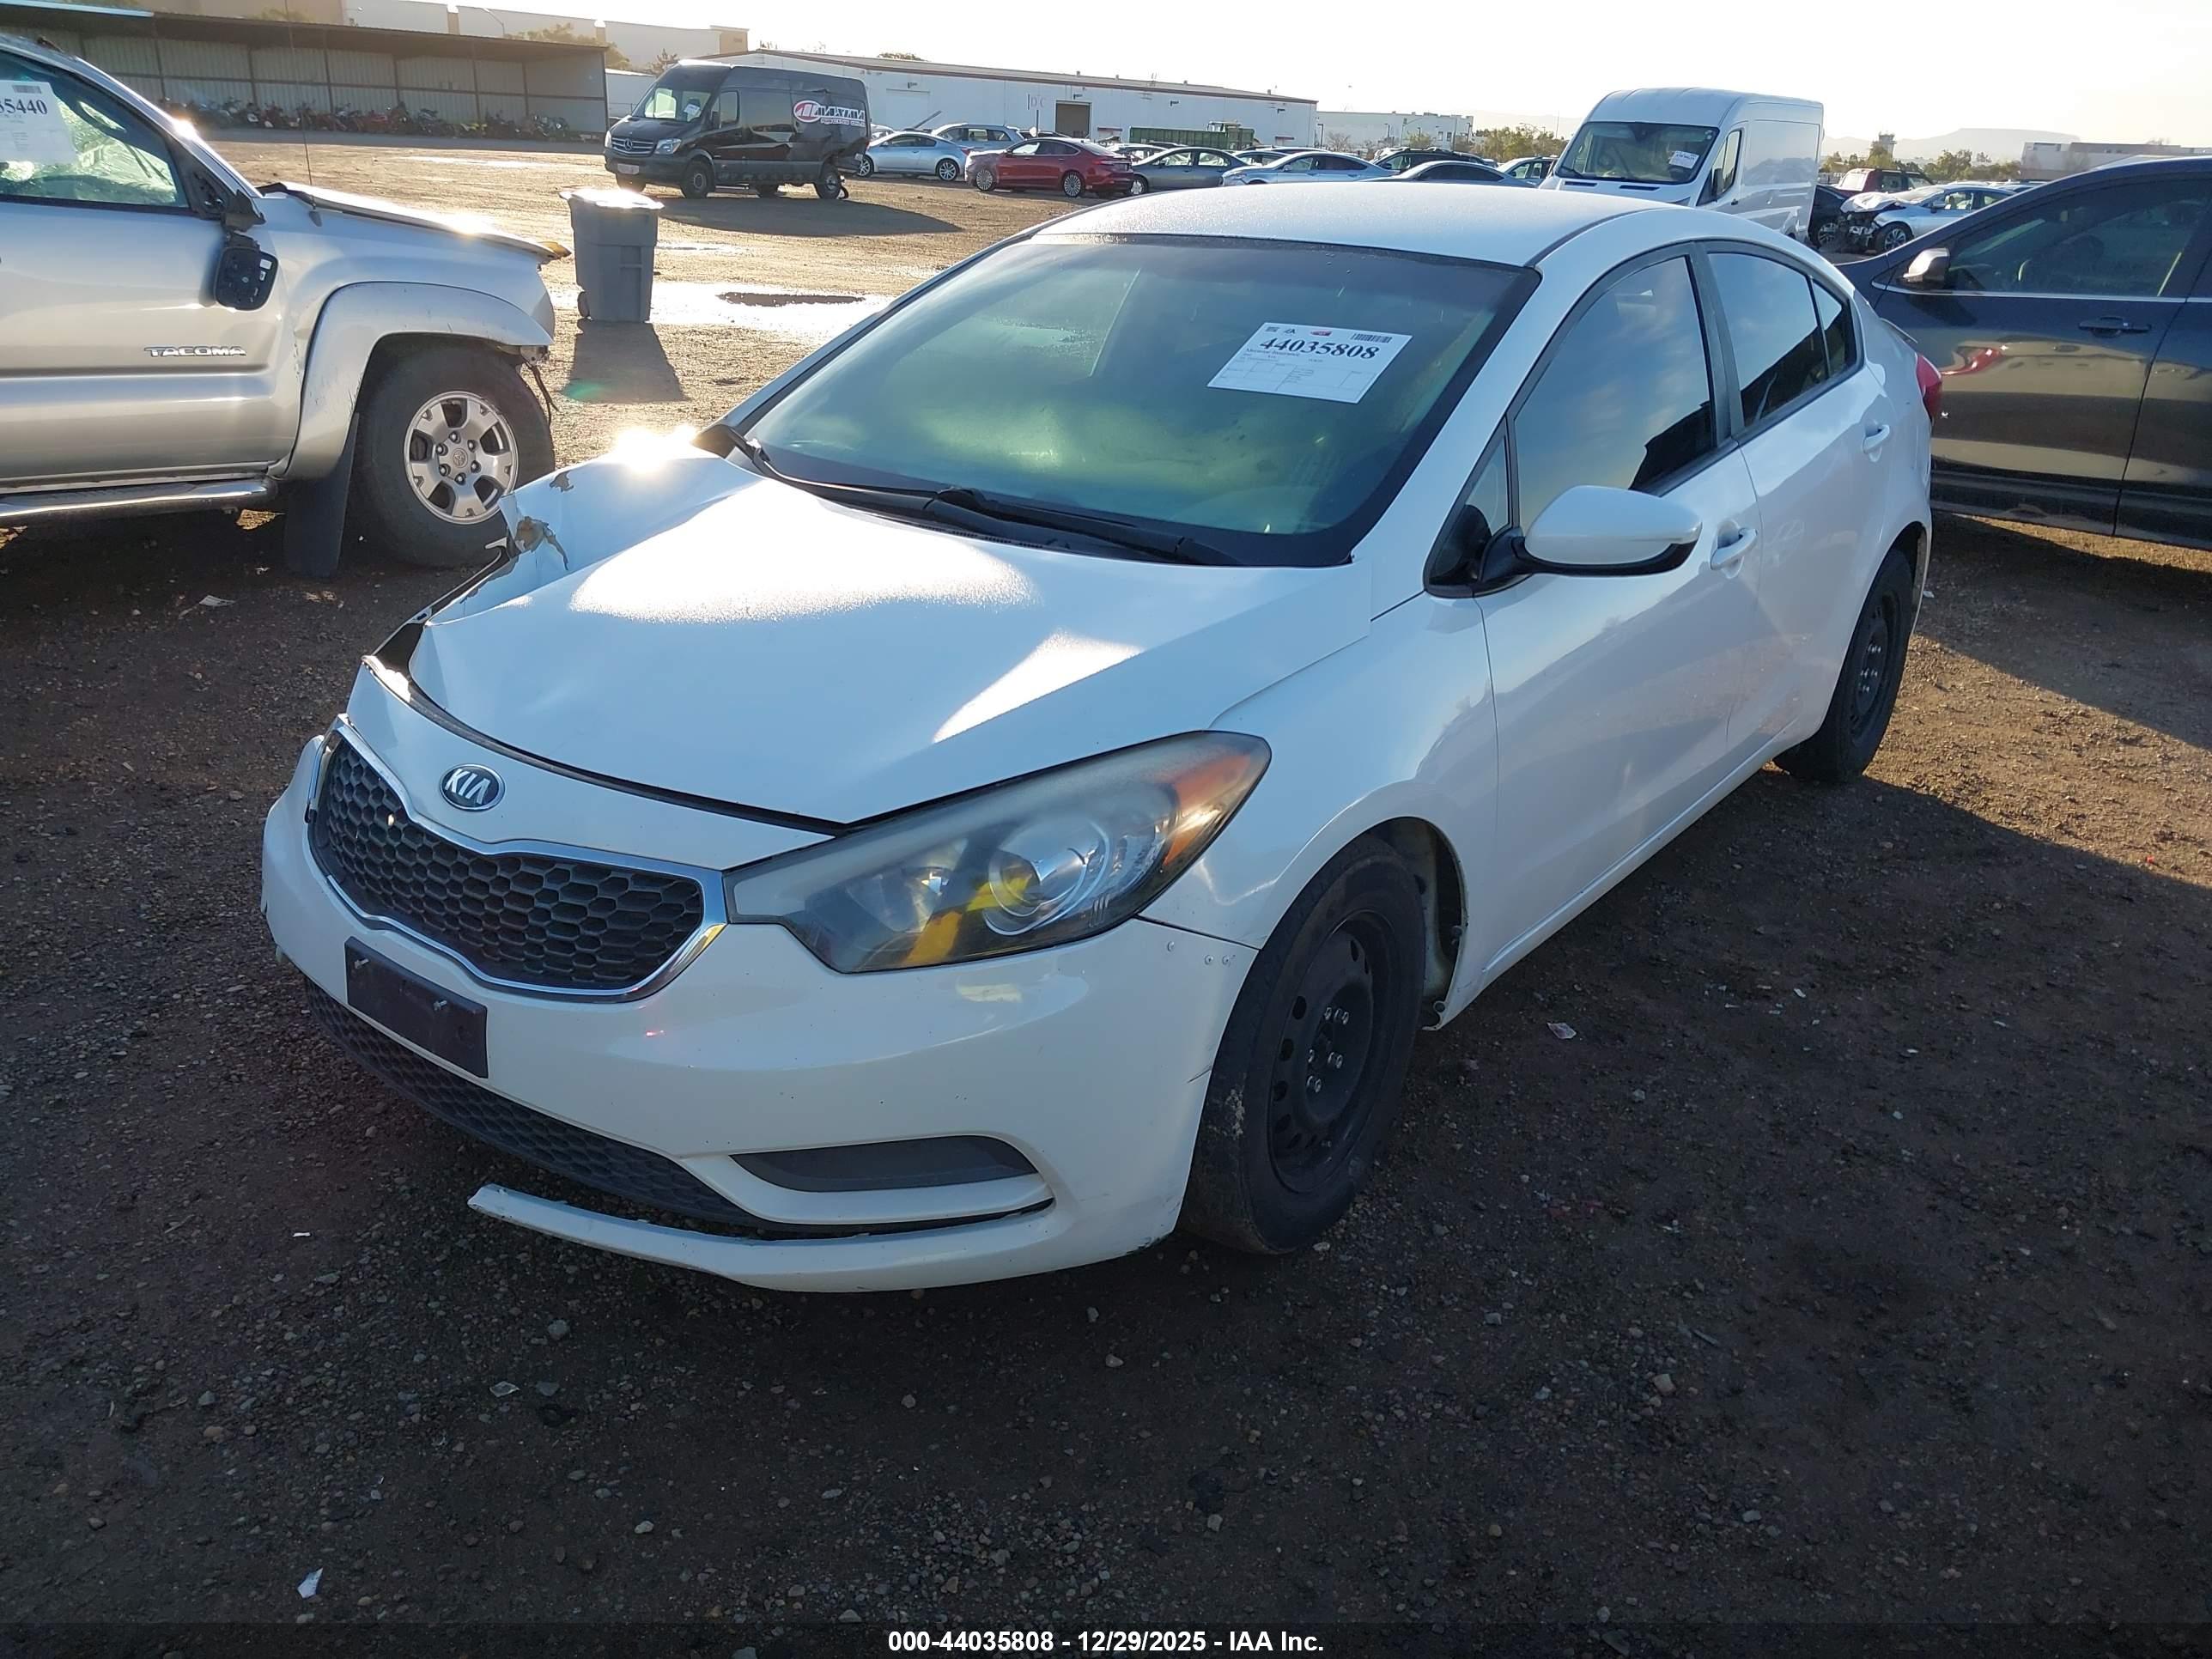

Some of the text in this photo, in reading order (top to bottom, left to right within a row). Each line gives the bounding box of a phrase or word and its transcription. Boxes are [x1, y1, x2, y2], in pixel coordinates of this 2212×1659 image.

[144, 346, 246, 357] TACOMA
[1260, 337, 1379, 359] 44035808
[445, 769, 490, 805] KIA
